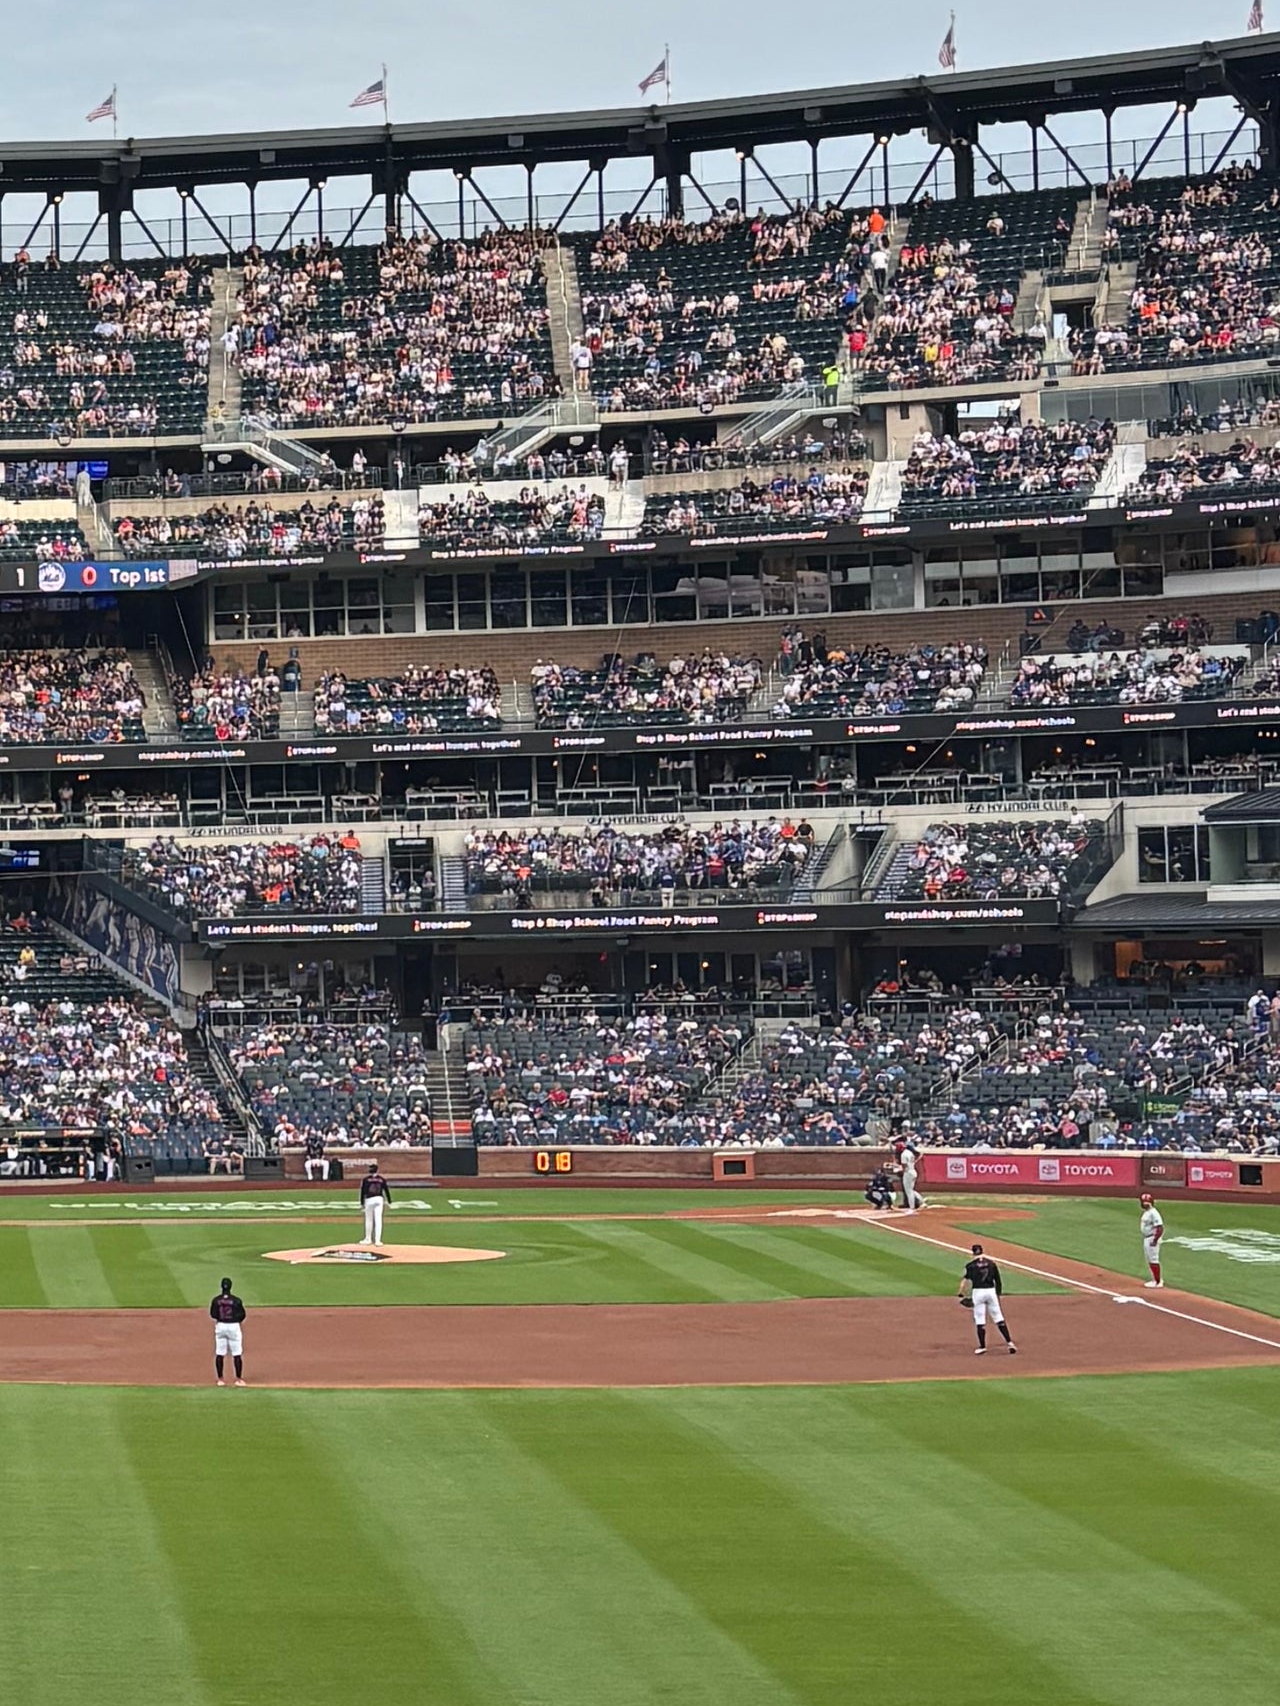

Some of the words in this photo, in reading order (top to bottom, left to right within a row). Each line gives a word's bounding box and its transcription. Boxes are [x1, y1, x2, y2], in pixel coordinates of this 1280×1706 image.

[16, 567, 25, 587] 1
[81, 566, 97, 585] 0
[110, 568, 141, 587] Top
[144, 567, 166, 583] 1st
[207, 924, 230, 935] Let's
[231, 924, 251, 934] end
[252, 923, 290, 934] student
[291, 923, 332, 935] hunger,
[511, 918, 536, 930] Stop
[546, 917, 573, 930] Shop
[574, 916, 610, 927] School
[610, 915, 637, 926] Food
[638, 915, 672, 928] Pantry
[673, 914, 719, 926] Program
[970, 1163, 1019, 1175] TOYOTA
[1063, 1164, 1114, 1177] TOYOTA
